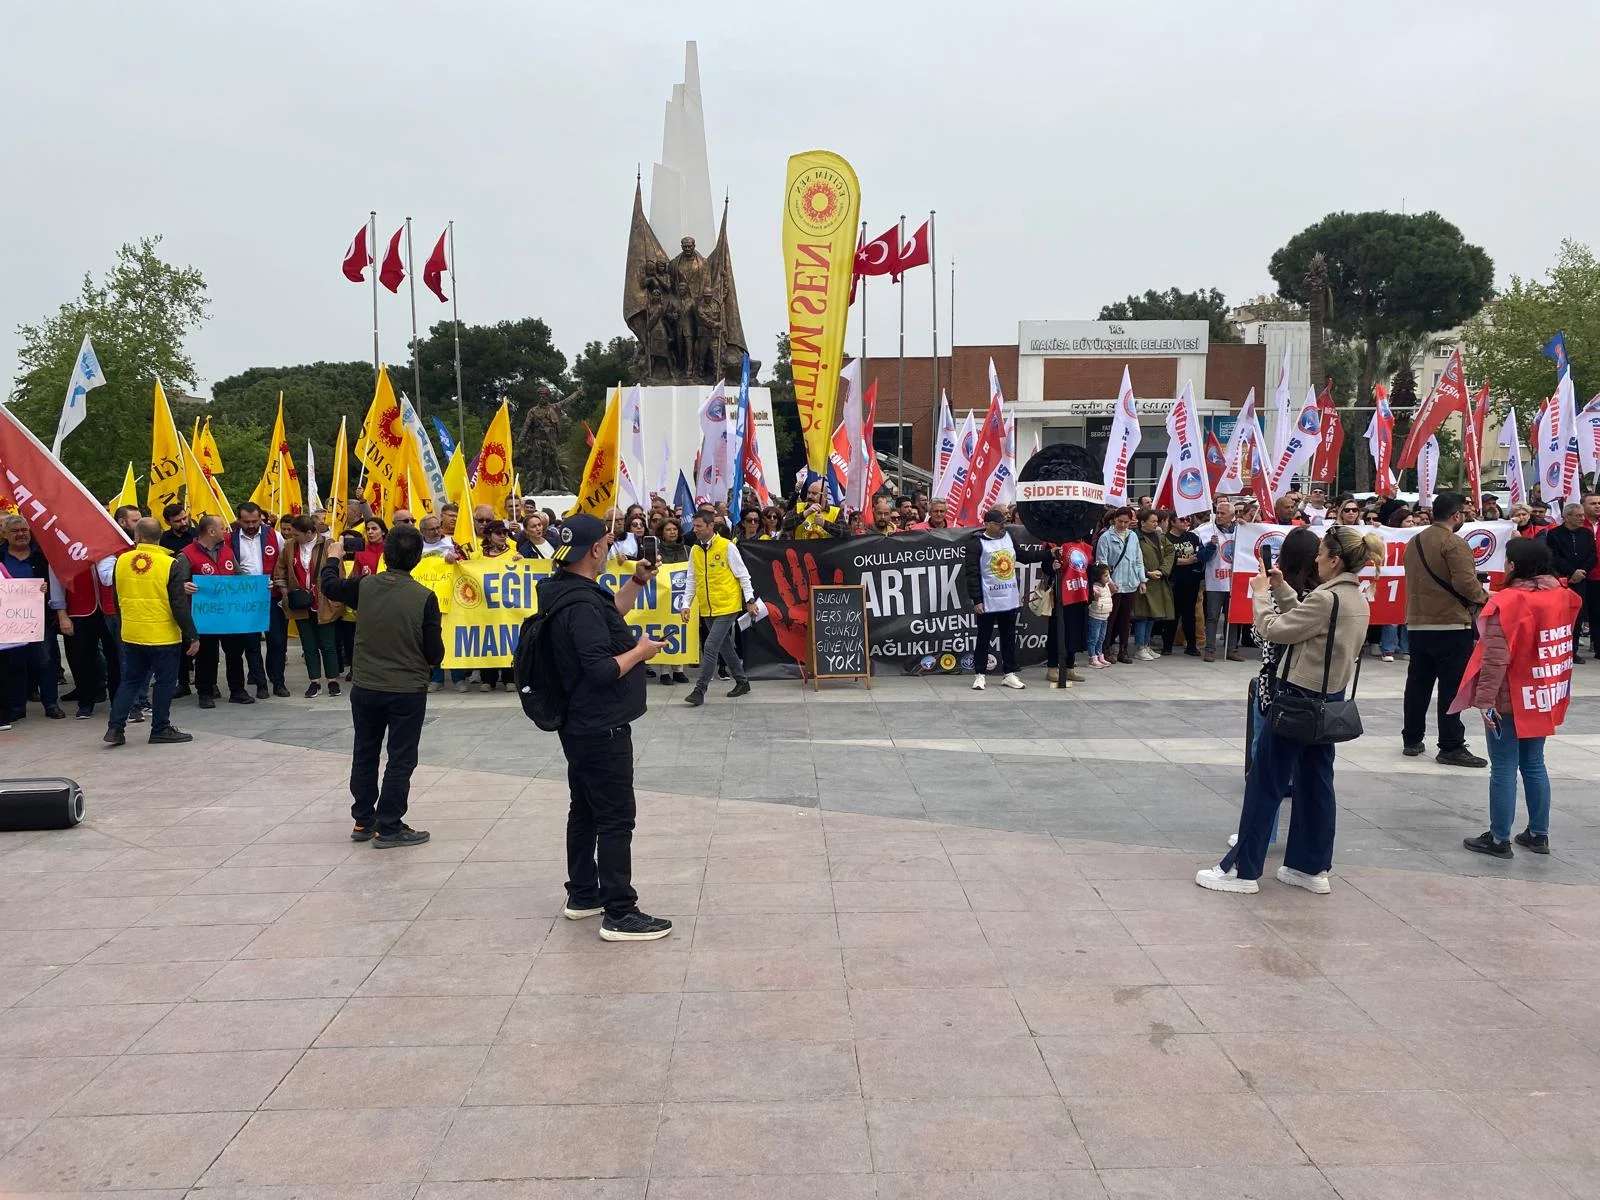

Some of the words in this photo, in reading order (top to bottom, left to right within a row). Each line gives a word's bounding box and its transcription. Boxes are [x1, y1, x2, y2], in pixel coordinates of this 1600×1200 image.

[1031, 337, 1070, 350] MANİSA
[1073, 337, 1140, 351] BÜYÜKŞEHİR
[1141, 337, 1199, 349] BELEDİYESİ
[1024, 484, 1079, 499] ŞİDDETE
[1082, 486, 1104, 500] HAYIR
[854, 551, 913, 567] OKULLAR
[915, 546, 967, 561] GÜVENS
[861, 564, 962, 617] ARTIK
[6, 608, 37, 619] OKUL
[816, 609, 842, 623] DERS
[910, 613, 978, 635] GÜVENL
[455, 625, 520, 657] MAN
[870, 639, 939, 657] AĞLIKLI
[942, 632, 1000, 653] EĞİTM
[826, 652, 861, 672] YOK!
